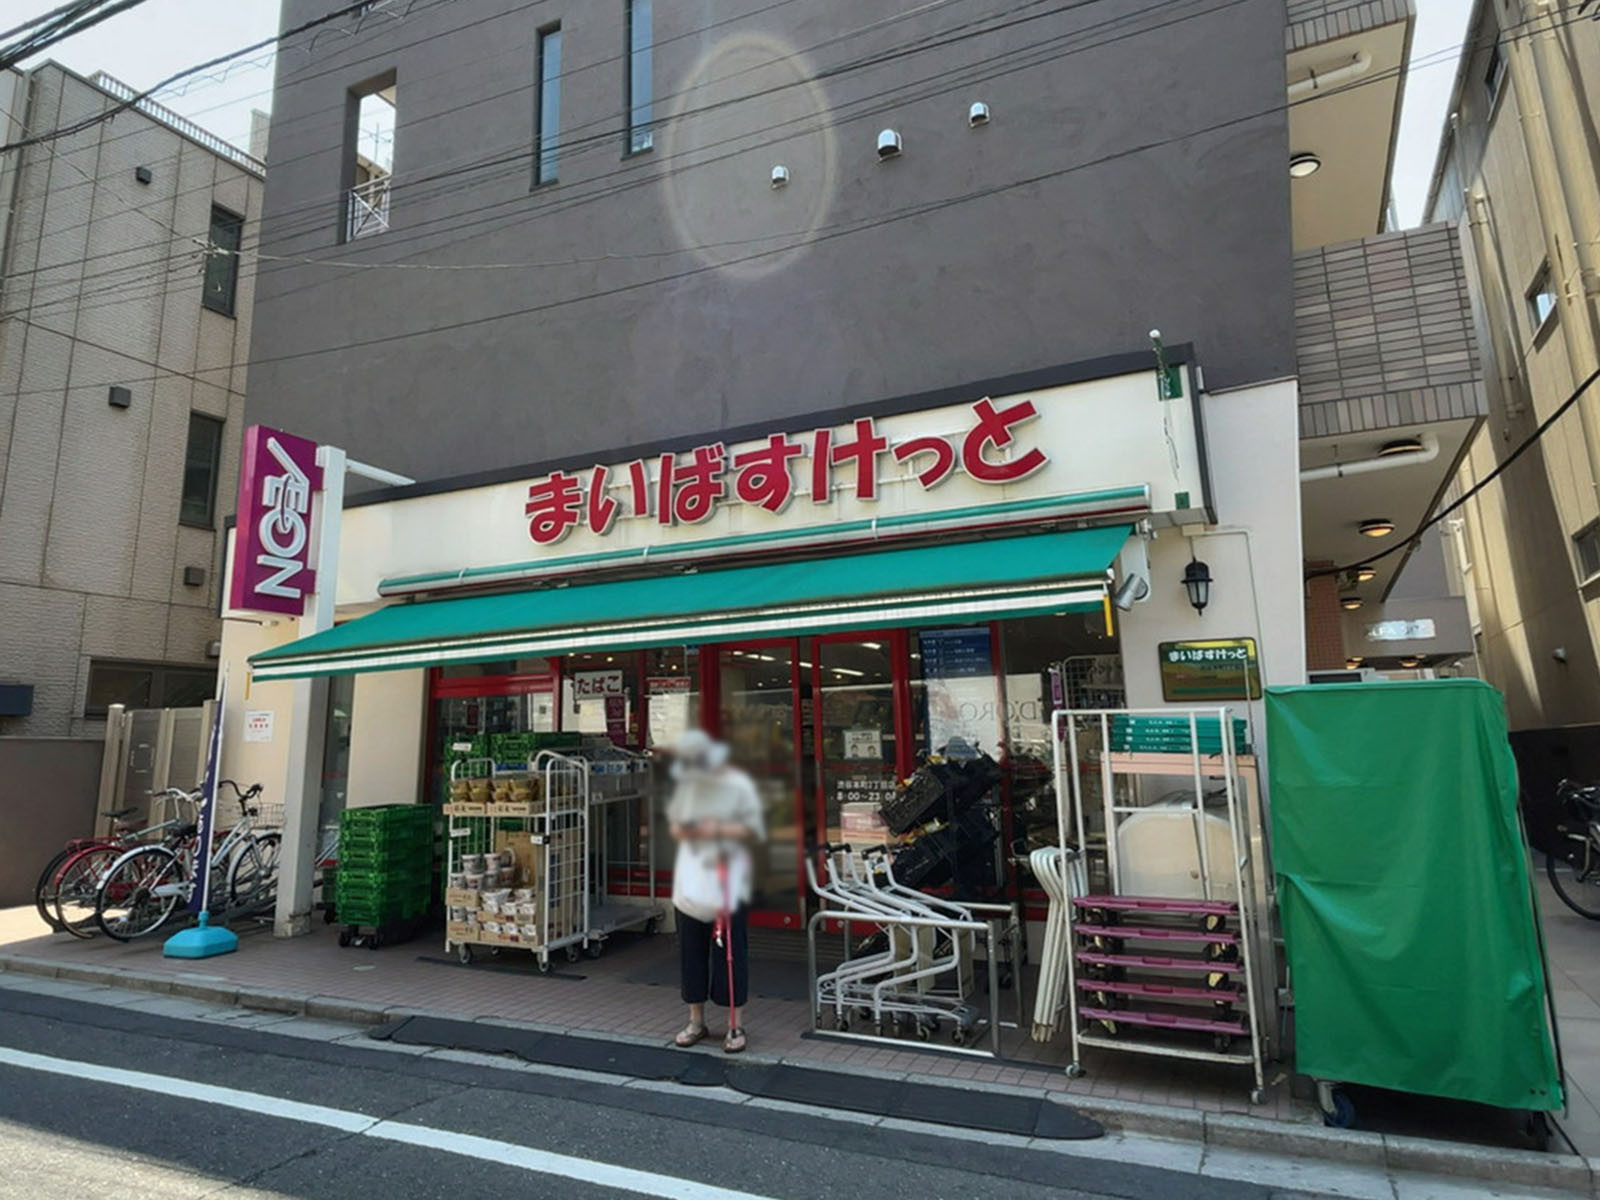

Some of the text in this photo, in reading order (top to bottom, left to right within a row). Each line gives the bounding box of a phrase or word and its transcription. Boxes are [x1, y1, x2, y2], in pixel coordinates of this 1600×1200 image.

[523, 396, 1049, 546] まいばすけっと
[254, 437, 310, 599] AEON
[577, 675, 620, 694] たばこ
[1168, 648, 1247, 662] まいばすけっと
